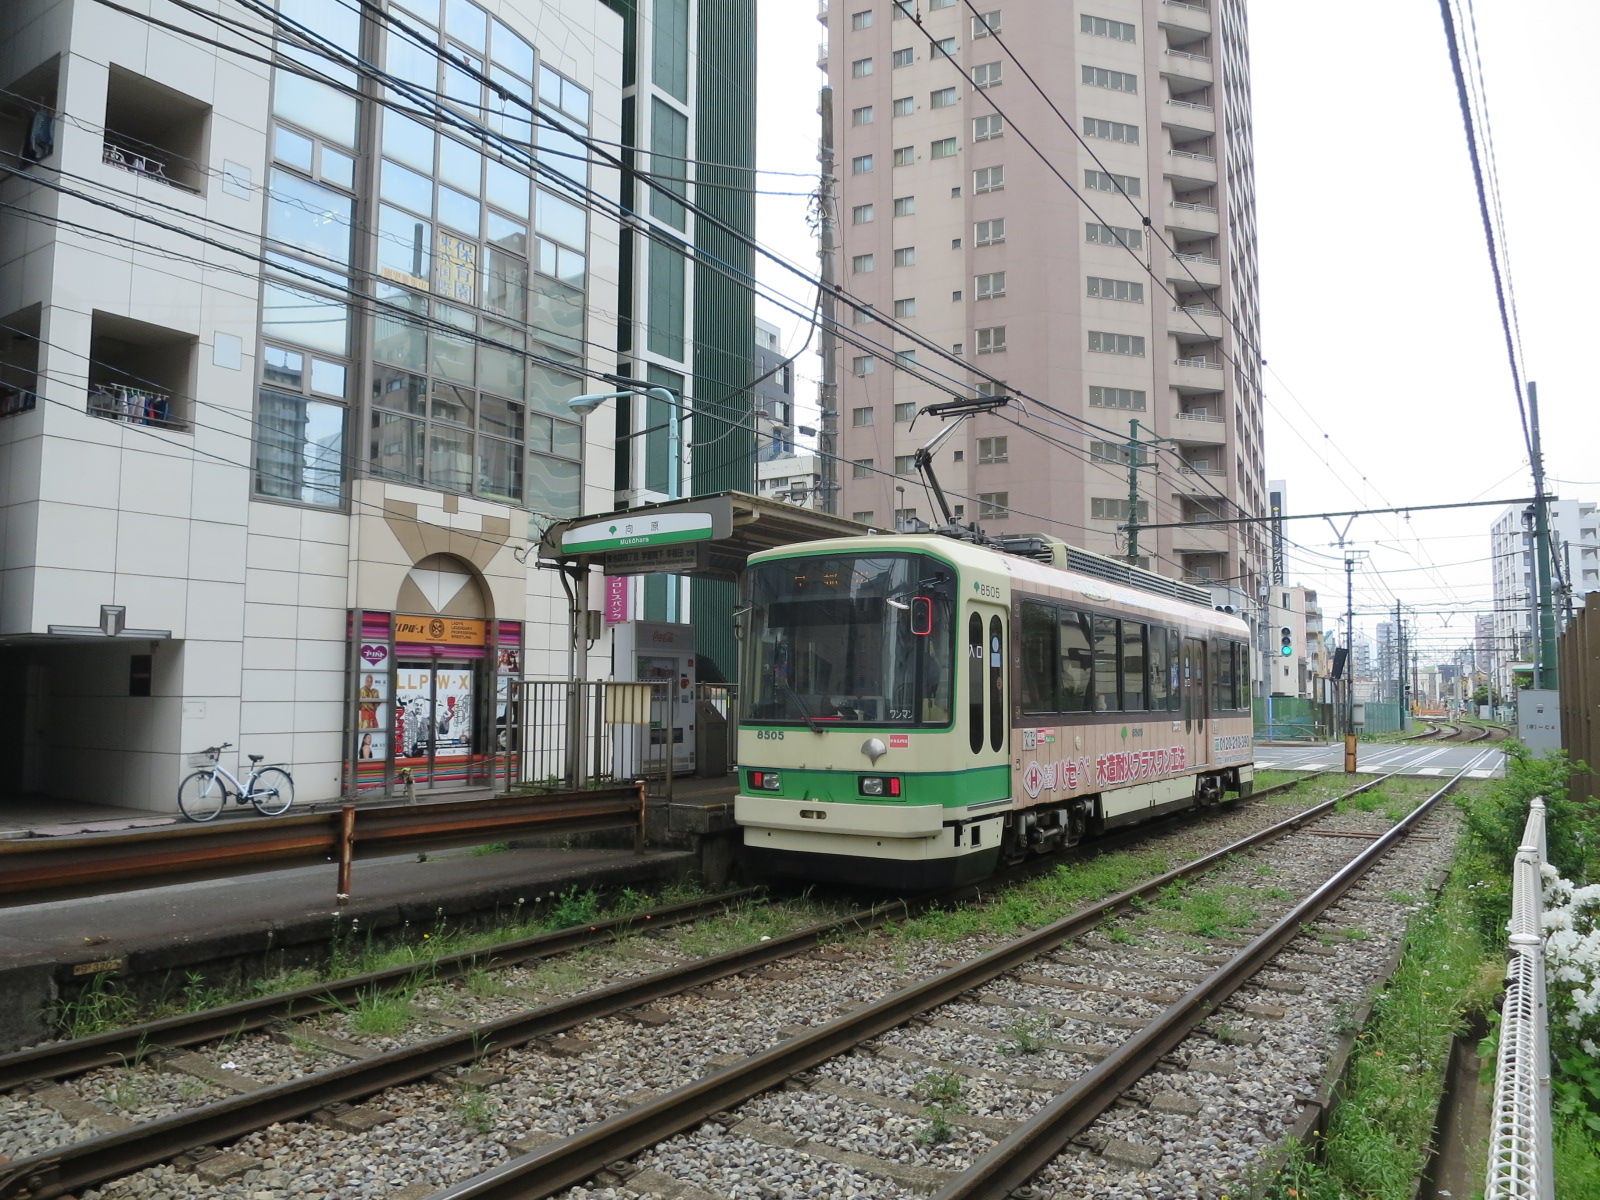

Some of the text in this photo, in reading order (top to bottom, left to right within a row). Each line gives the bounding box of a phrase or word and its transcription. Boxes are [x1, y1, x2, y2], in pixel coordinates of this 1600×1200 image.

[980, 583, 1001, 599] 8505
[969, 644, 983, 659] 入口
[889, 709, 913, 719] ワンマン
[756, 730, 785, 741] 8505
